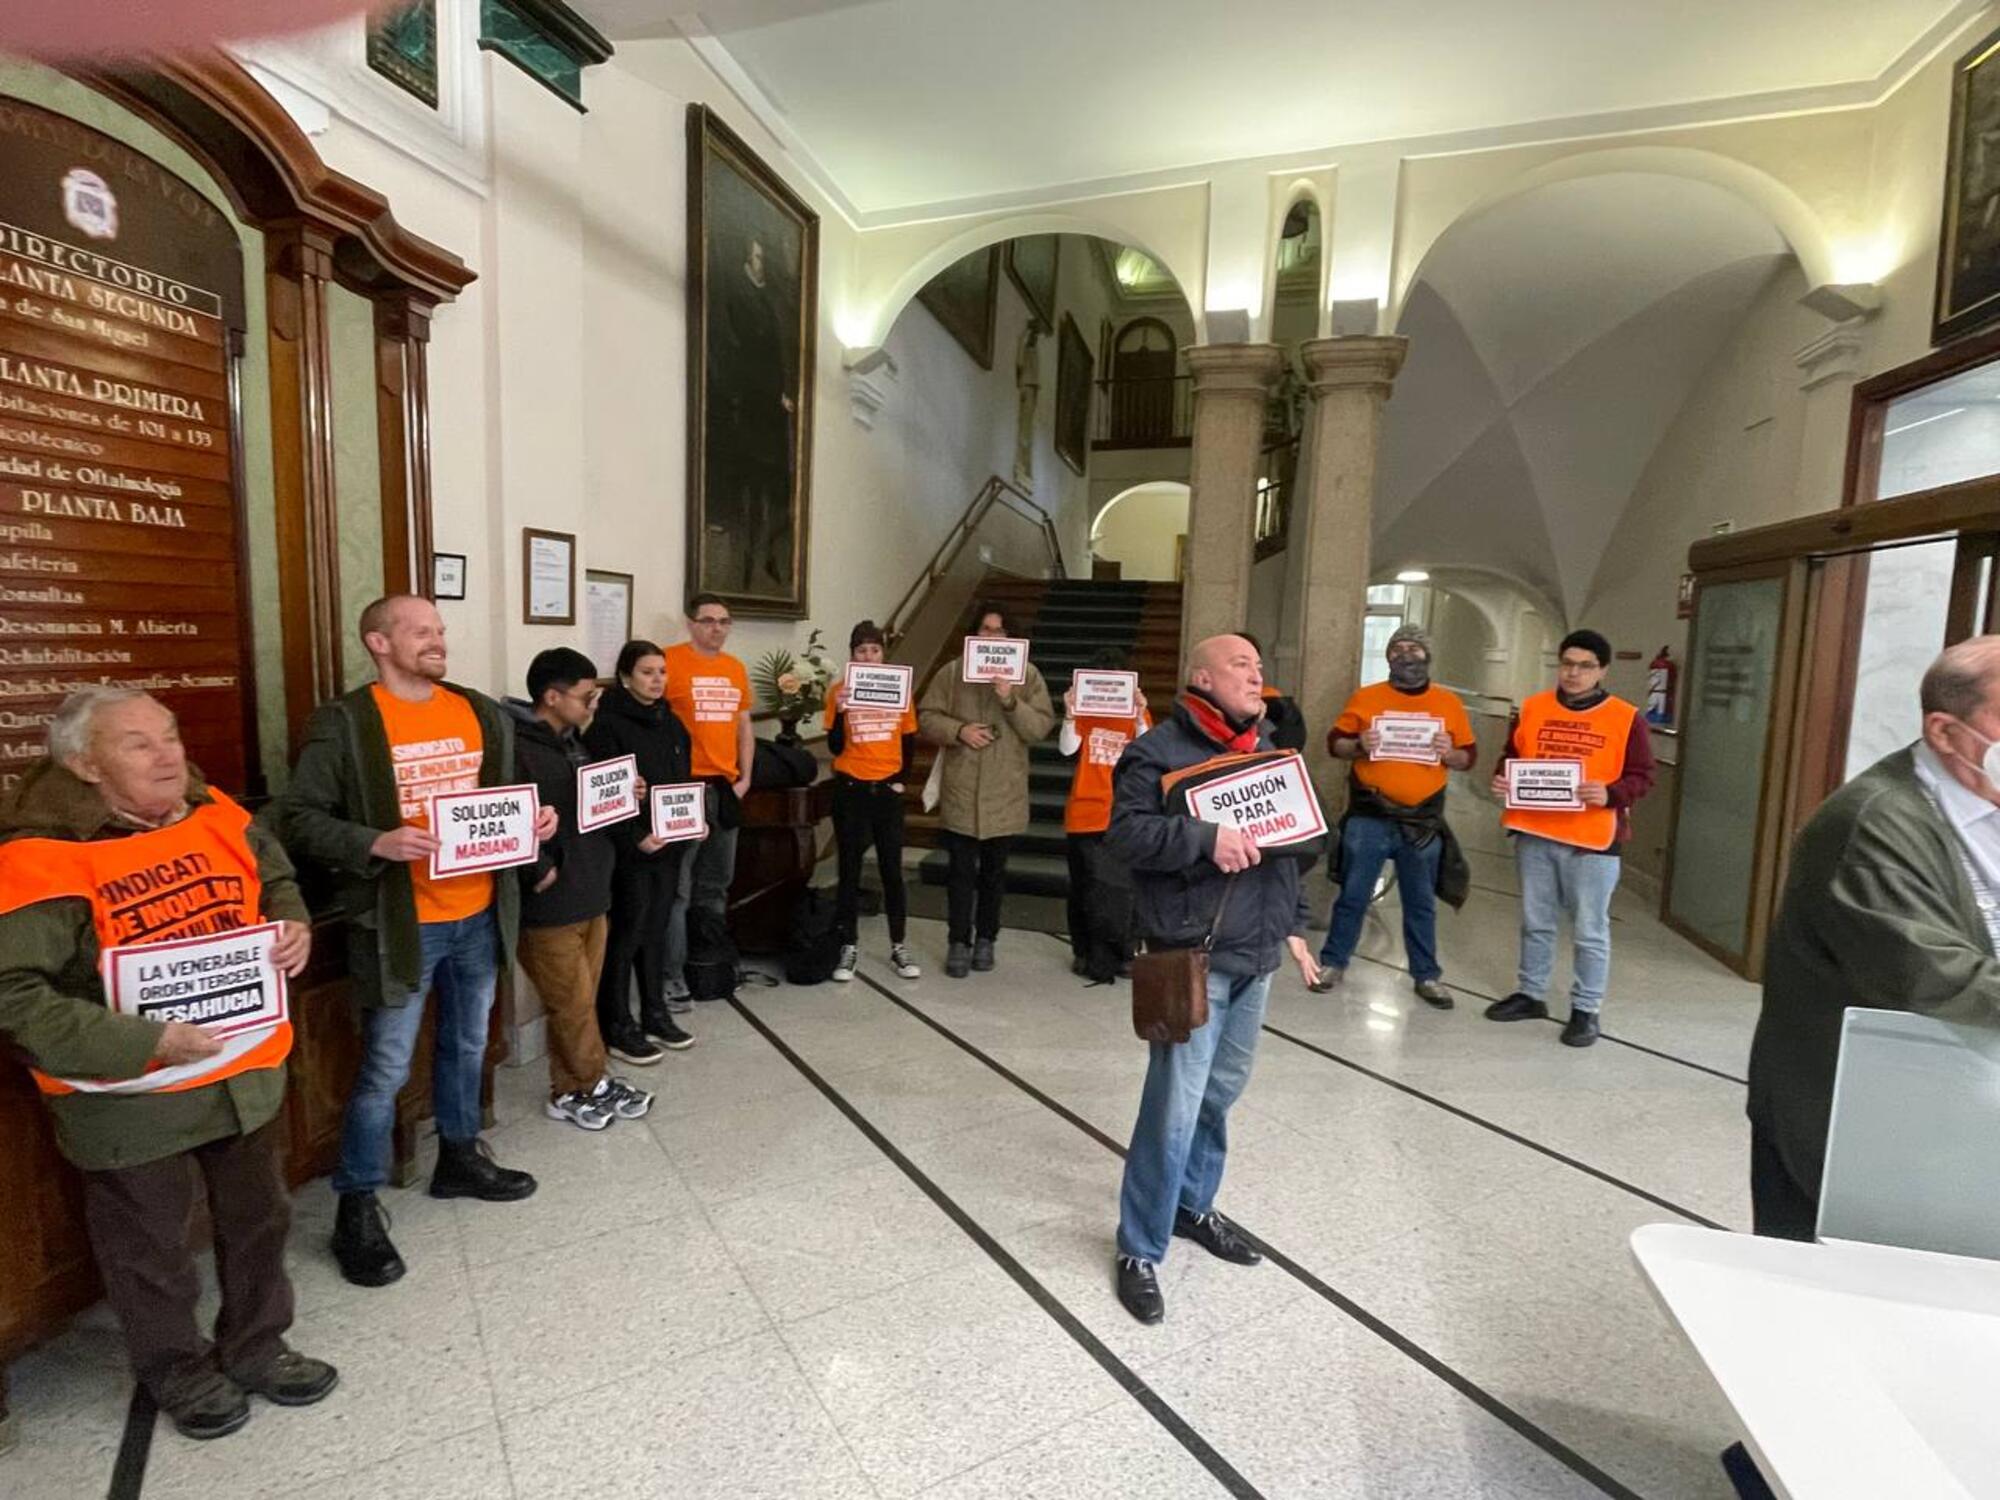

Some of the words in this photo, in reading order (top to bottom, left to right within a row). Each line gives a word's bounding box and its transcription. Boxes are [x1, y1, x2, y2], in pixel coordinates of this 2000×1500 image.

[16, 298, 43, 319] de
[87, 286, 199, 337] SEGUNDA
[93, 379, 205, 421] PRIMERA
[106, 413, 132, 432] de
[46, 463, 72, 481] de
[21, 490, 122, 521] PLANTA
[130, 503, 186, 528] BAJA
[135, 619, 198, 635] Abierta
[399, 766, 418, 781] DE
[599, 785, 620, 800] PARA
[1211, 774, 1288, 811] SOLUCIÓN
[451, 798, 521, 823] SOLUCIÓN
[1233, 799, 1277, 825] PARA
[469, 821, 507, 840] PARA
[1240, 812, 1297, 841] ARIANO
[455, 836, 520, 861] MARIANO
[139, 965, 163, 983] LA
[167, 945, 261, 978] VENERABLE
[139, 978, 195, 1001] ORDEN
[198, 965, 262, 992] TERCERA
